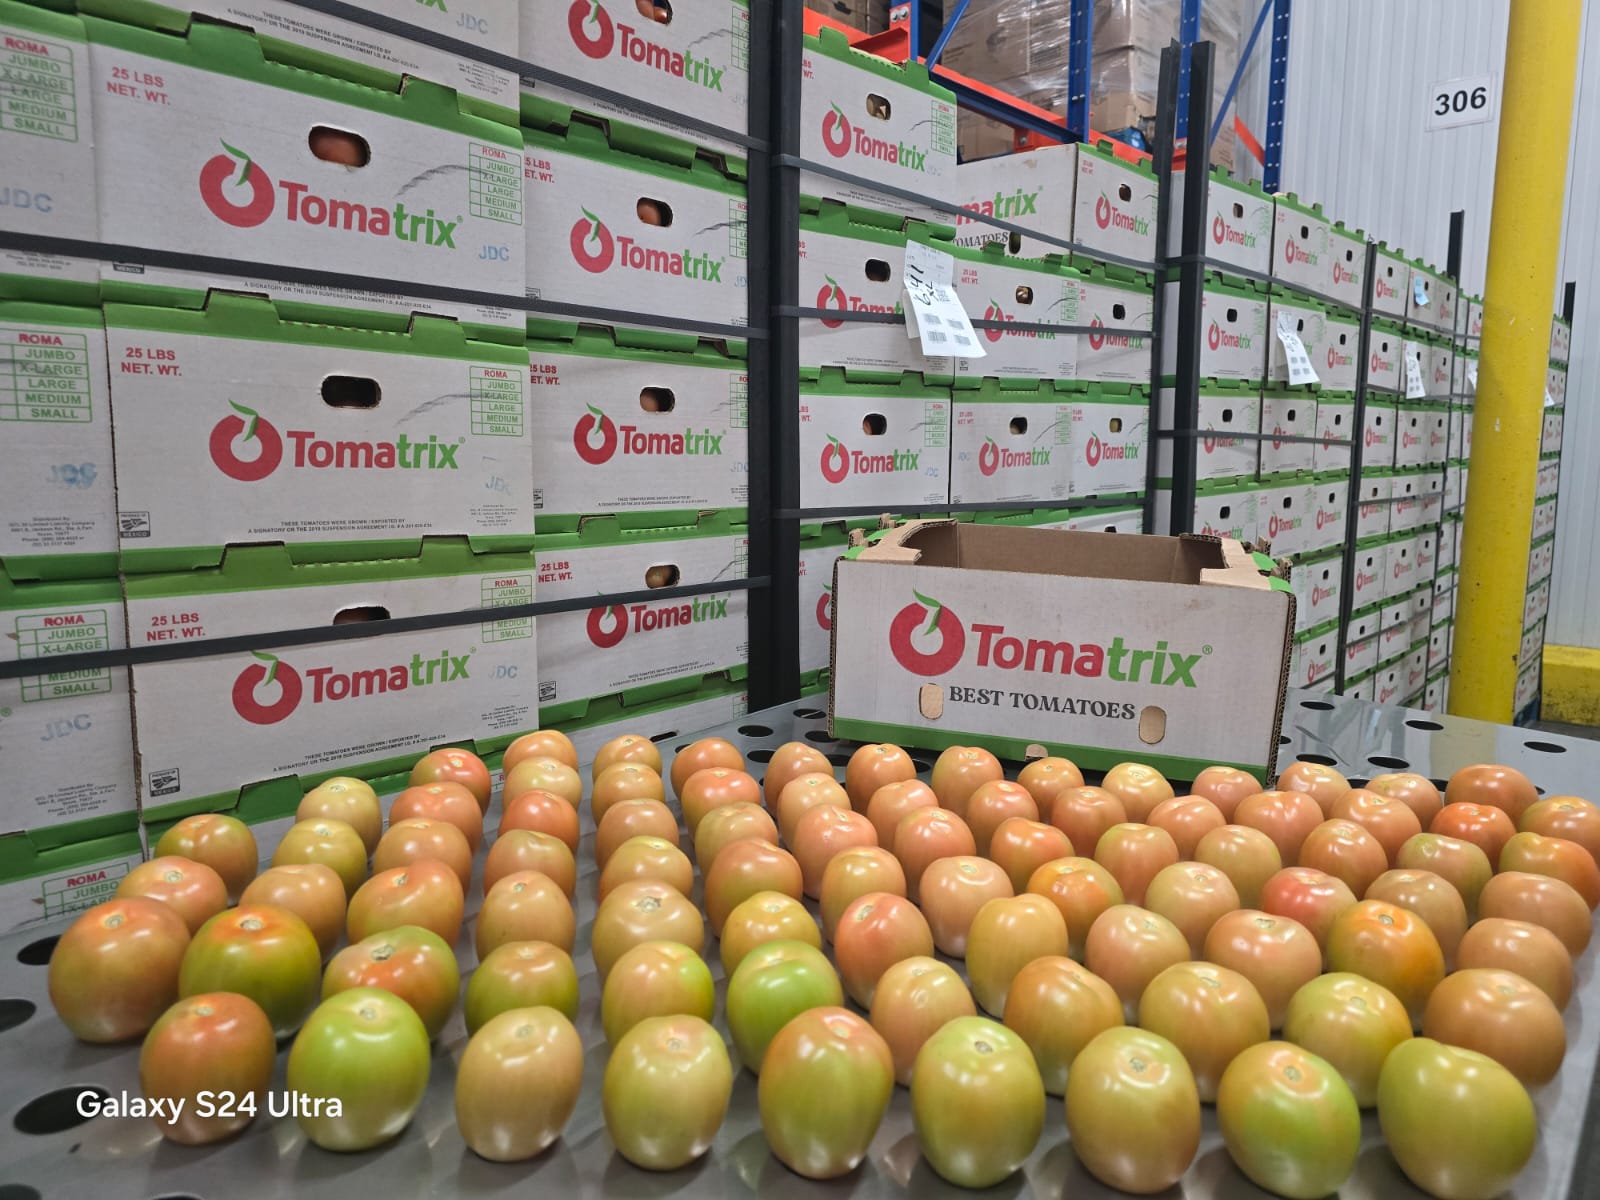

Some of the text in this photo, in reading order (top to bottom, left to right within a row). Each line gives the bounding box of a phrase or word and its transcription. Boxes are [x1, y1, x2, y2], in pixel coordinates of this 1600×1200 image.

[5, 37, 49, 55] ROMA
[8, 54, 61, 73] JUMBO
[1, 67, 68, 90] X-LARGE
[112, 67, 164, 87] 25 LBS
[10, 84, 62, 104] LARGE
[107, 82, 170, 105] NET. WT.
[1434, 87, 1487, 116] 306
[9, 102, 66, 121] MEDIUM
[14, 117, 64, 135] SMALL
[482, 146, 507, 161] ROMA
[486, 161, 514, 175] JUMBO
[531, 158, 551, 170] LBS
[483, 172, 519, 188] X-LARGE
[525, 169, 555, 184] ET. WT.
[487, 184, 515, 198] LARGE
[485, 196, 517, 210] MEDIUM
[957, 188, 1038, 225] matrix
[488, 208, 515, 221] SMALL
[479, 245, 510, 262] JDC
[18, 333, 63, 346] ROMA
[25, 348, 76, 361] JUMBO
[126, 347, 176, 361] 25 LBS
[19, 362, 83, 376] X-LARGE
[121, 362, 182, 377] NET. WT.
[484, 370, 507, 378] ROMA
[540, 365, 557, 374] LBS
[28, 378, 77, 390] LARGE
[487, 381, 516, 390] JUMBO
[531, 376, 560, 385] ET. WT.
[25, 393, 82, 405] MEDIUM
[31, 407, 80, 419] SMALL
[488, 403, 516, 412] LARGE
[486, 414, 518, 423] MEDIUM
[489, 425, 517, 434] SMALL
[541, 561, 569, 572] 25 LBS
[494, 579, 518, 588] ROMA
[538, 572, 573, 583] NET. WT.
[498, 588, 526, 597] JUMBO
[44, 615, 85, 627] ROMA
[151, 613, 200, 626] 25 LBS
[48, 627, 96, 640] JUMBO
[146, 627, 206, 641] NET. WT.
[500, 629, 526, 638] SMALL
[43, 640, 103, 653] X-LARGE
[53, 682, 99, 695] SMALL
[950, 686, 1135, 720] BEST TOMATOES
[67, 871, 107, 887] ROMA
